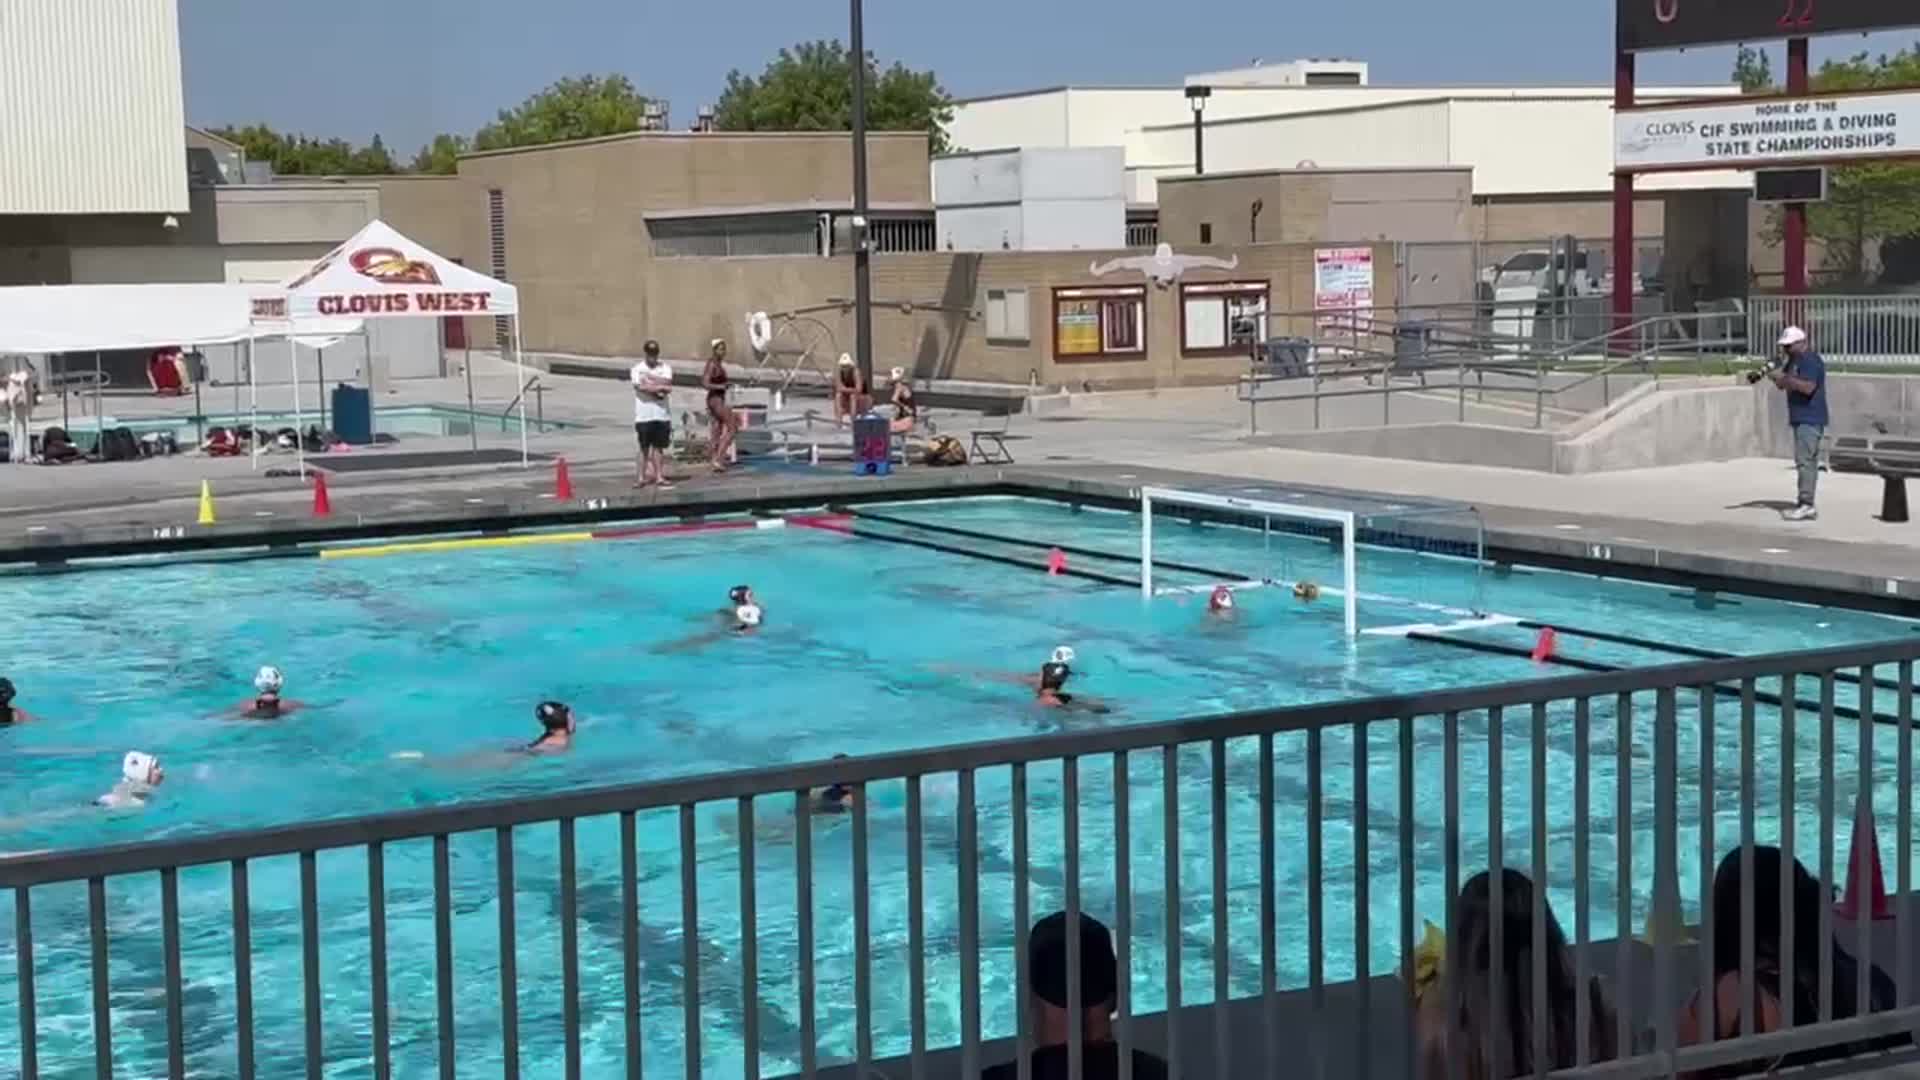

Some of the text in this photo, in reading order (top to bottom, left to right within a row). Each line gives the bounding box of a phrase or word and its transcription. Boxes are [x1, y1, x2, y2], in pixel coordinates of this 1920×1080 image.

[1756, 101, 1837, 115] HOME OF THE
[1646, 120, 1695, 136] CLOVIS
[1700, 123, 1724, 138] CIF
[1730, 118, 1817, 136] SWIMMING
[1839, 112, 1897, 130] DIVING
[1705, 132, 1896, 156] STATE CHAMPIONSHIPS
[318, 292, 490, 314] CLOVIS WEST
